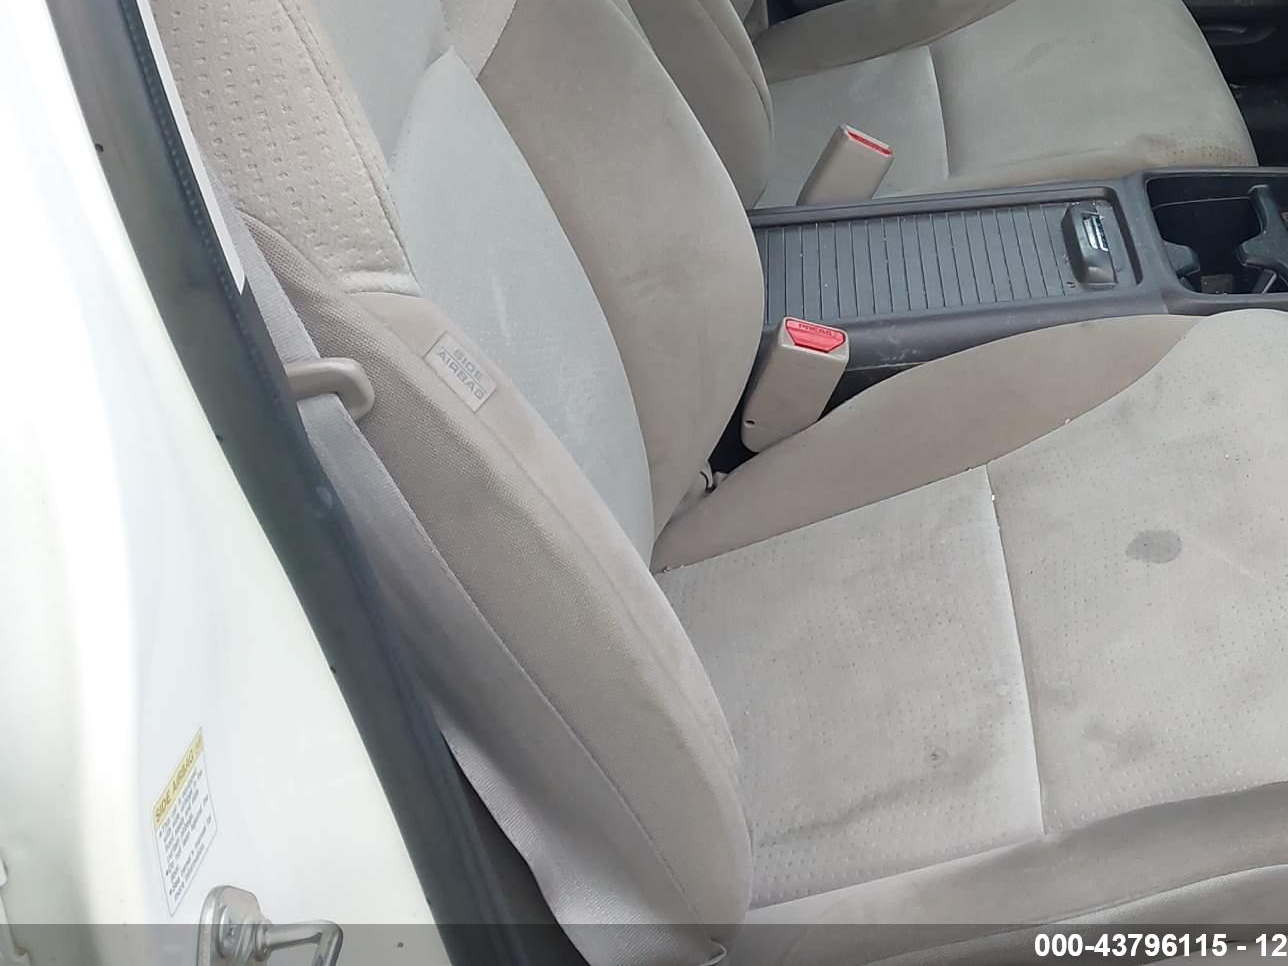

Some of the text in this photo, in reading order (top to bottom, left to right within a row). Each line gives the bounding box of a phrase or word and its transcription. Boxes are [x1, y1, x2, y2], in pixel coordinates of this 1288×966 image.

[437, 351, 485, 400] AIRBAG
[453, 348, 481, 382] SIDE
[155, 748, 194, 823] SIDE AIRBAG
